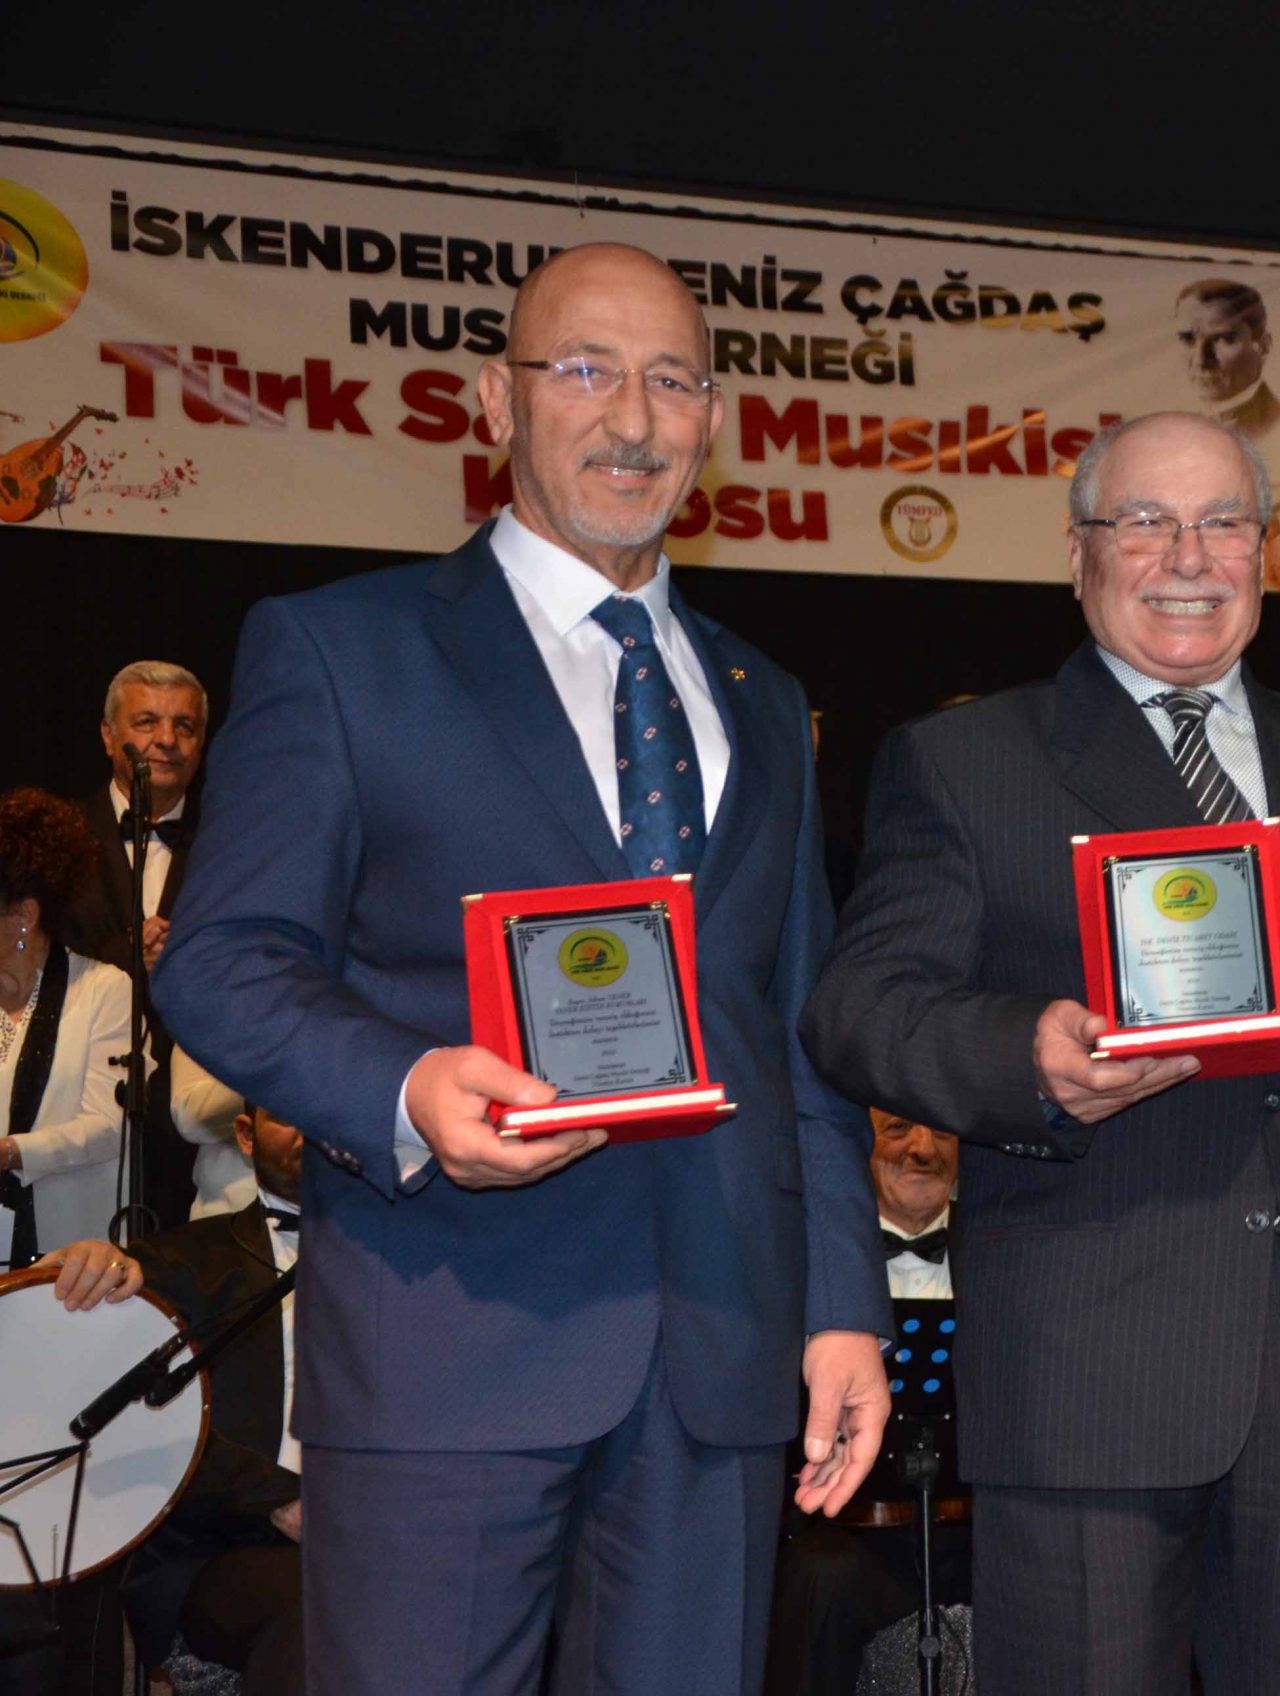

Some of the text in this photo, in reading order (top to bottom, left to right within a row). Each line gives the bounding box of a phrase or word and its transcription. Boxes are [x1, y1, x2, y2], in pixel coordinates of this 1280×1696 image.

[110, 189, 1106, 343] İSKENDERU ENİZ ÇAĞDAŞ
[99, 340, 373, 438] Türk
[738, 393, 1122, 480] Musıkis
[349, 297, 916, 387] MUS RNEĞİ
